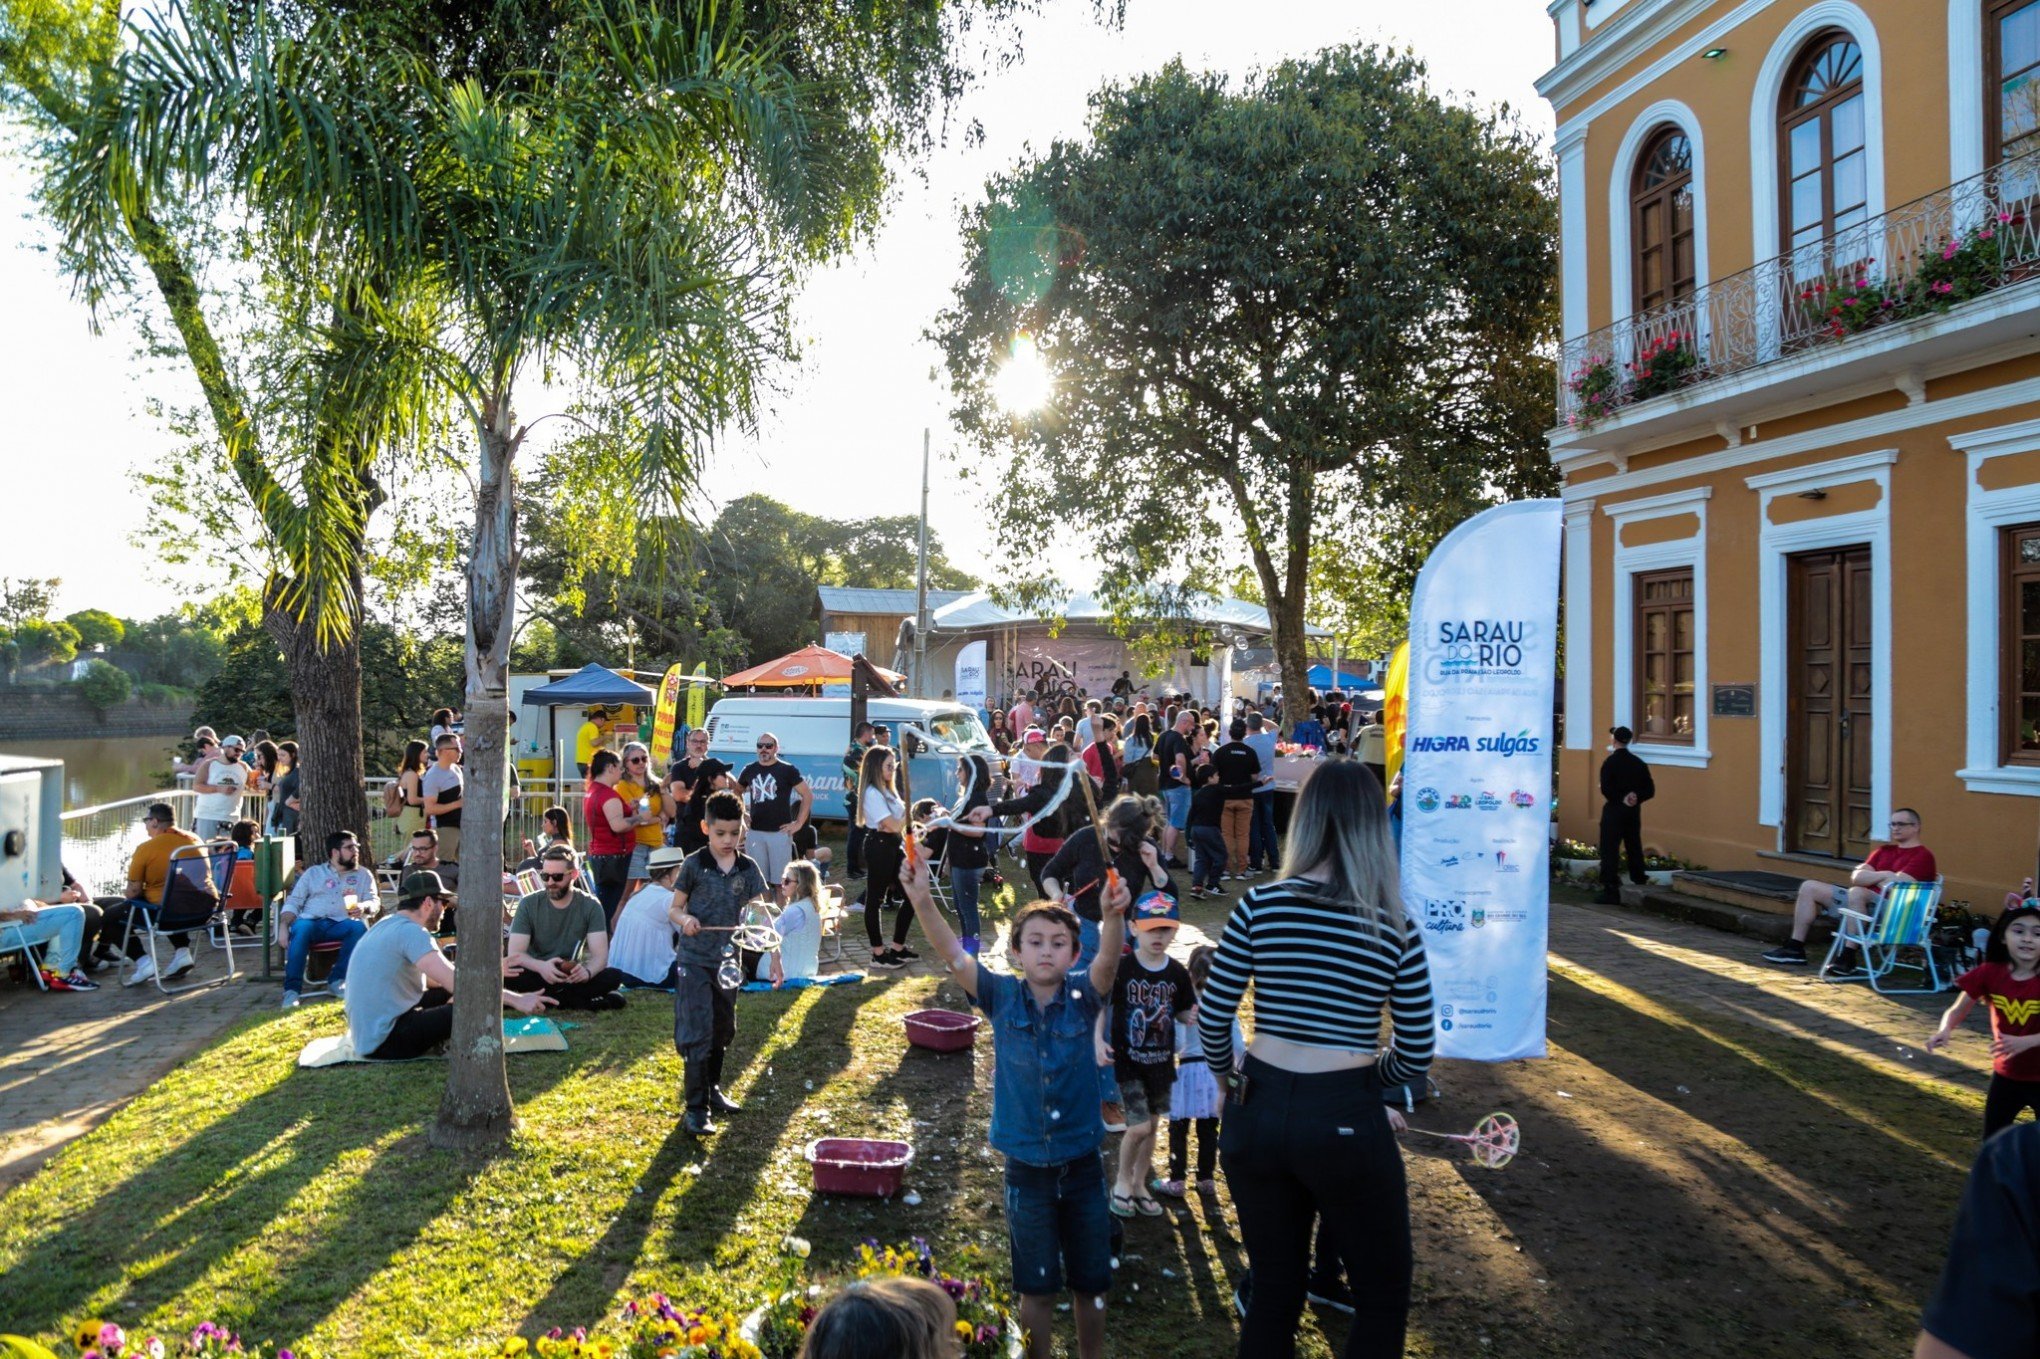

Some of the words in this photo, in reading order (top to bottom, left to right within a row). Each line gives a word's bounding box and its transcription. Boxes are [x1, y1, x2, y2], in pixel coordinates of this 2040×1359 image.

[1440, 620, 1522, 643] SARAU
[1447, 644, 1472, 659] DO
[1479, 644, 1522, 666] RIO
[1412, 736, 1471, 753] HIGRA
[1425, 919, 1465, 934] cultura
